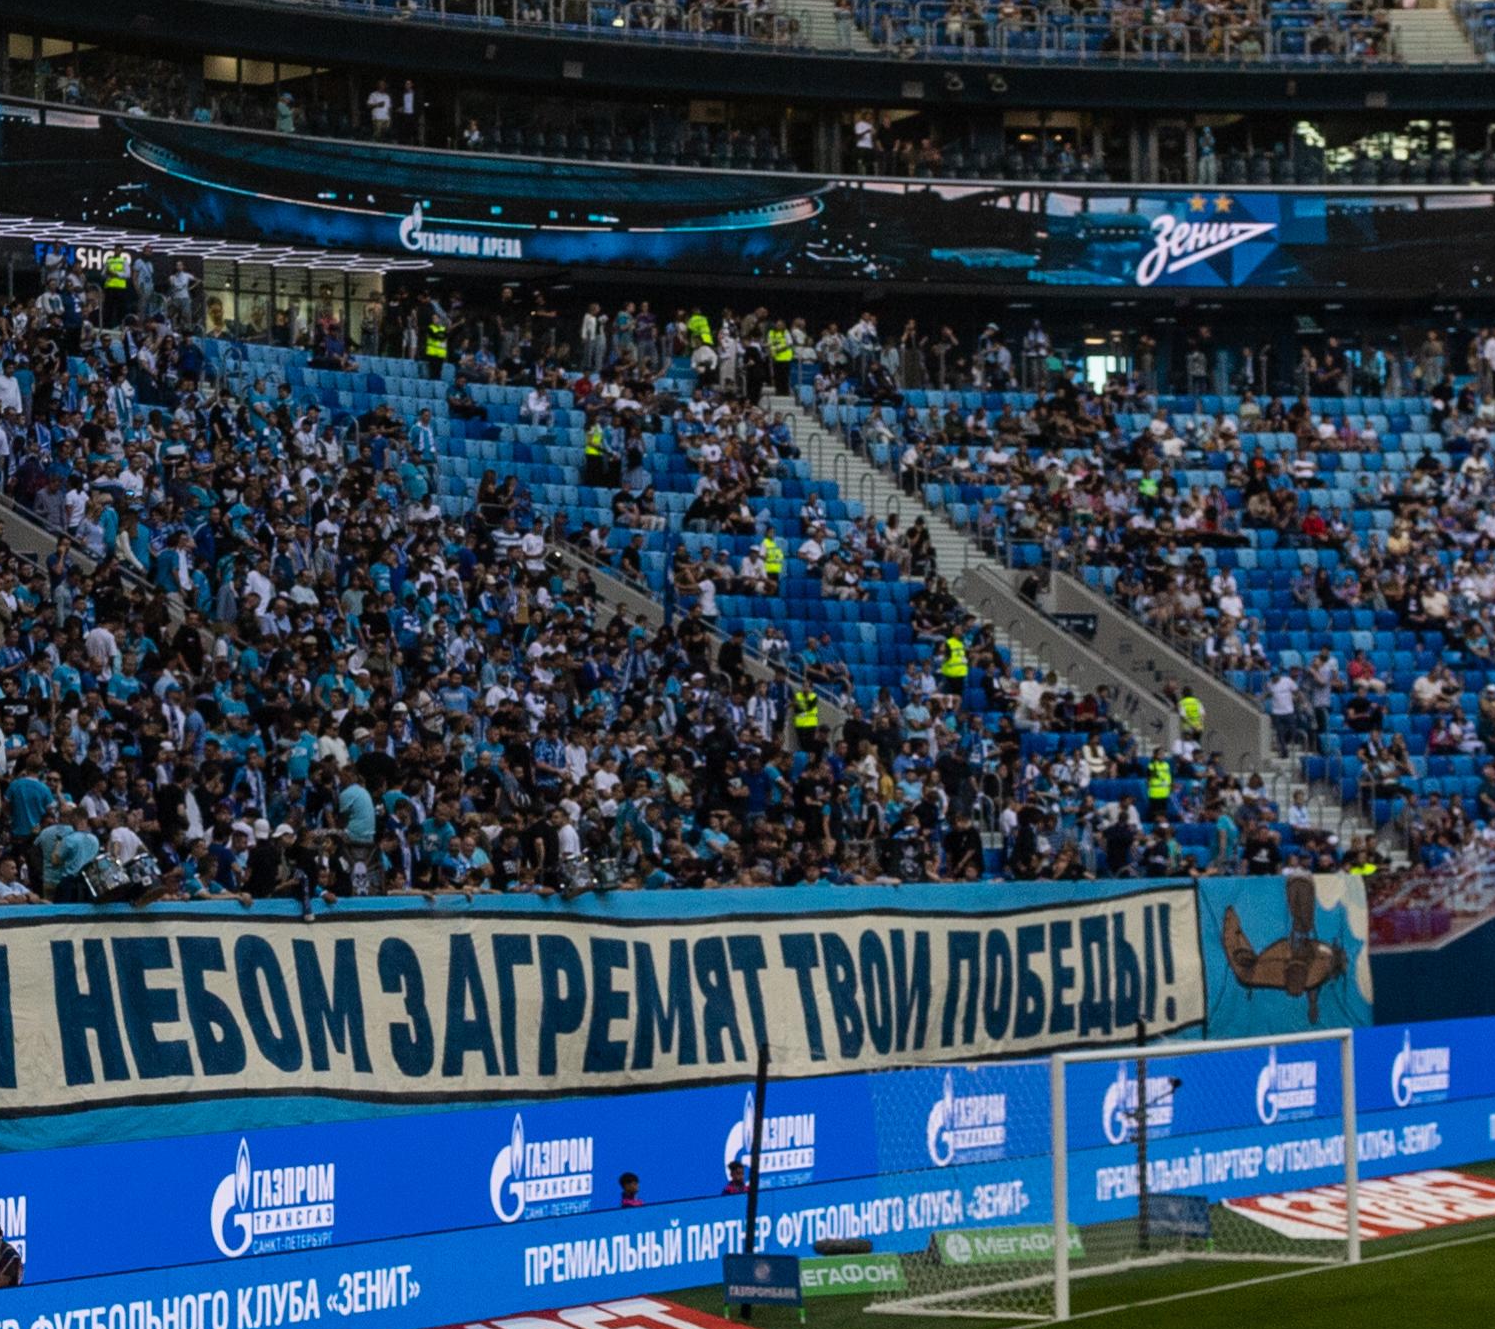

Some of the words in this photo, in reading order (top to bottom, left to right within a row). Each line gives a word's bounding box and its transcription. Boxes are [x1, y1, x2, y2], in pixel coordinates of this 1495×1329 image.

[1136, 214, 1279, 287] Зенит
[50, 933, 370, 1086] НЕБОМ
[379, 933, 770, 1080] ЗАГРЕМЯТ
[779, 927, 931, 1060] ТВОИ
[942, 901, 1179, 1042] ПОБЕДЫ!
[525, 1137, 593, 1178] ГАЗПРОМ
[760, 1114, 815, 1149] АЗПРОМ
[252, 1162, 335, 1209] ГАЗПРОМ
[255, 1205, 334, 1234] ТРАНСГАЗ
[525, 1219, 683, 1286] ПРЕМИАЛЬНЫЙ
[776, 1196, 904, 1249] ФУТБОЛЬНОГО
[908, 1189, 964, 1229] КЛУБА
[236, 1275, 321, 1329] КЛУБА
[326, 1265, 422, 1316] «ЗЕНИТ»
